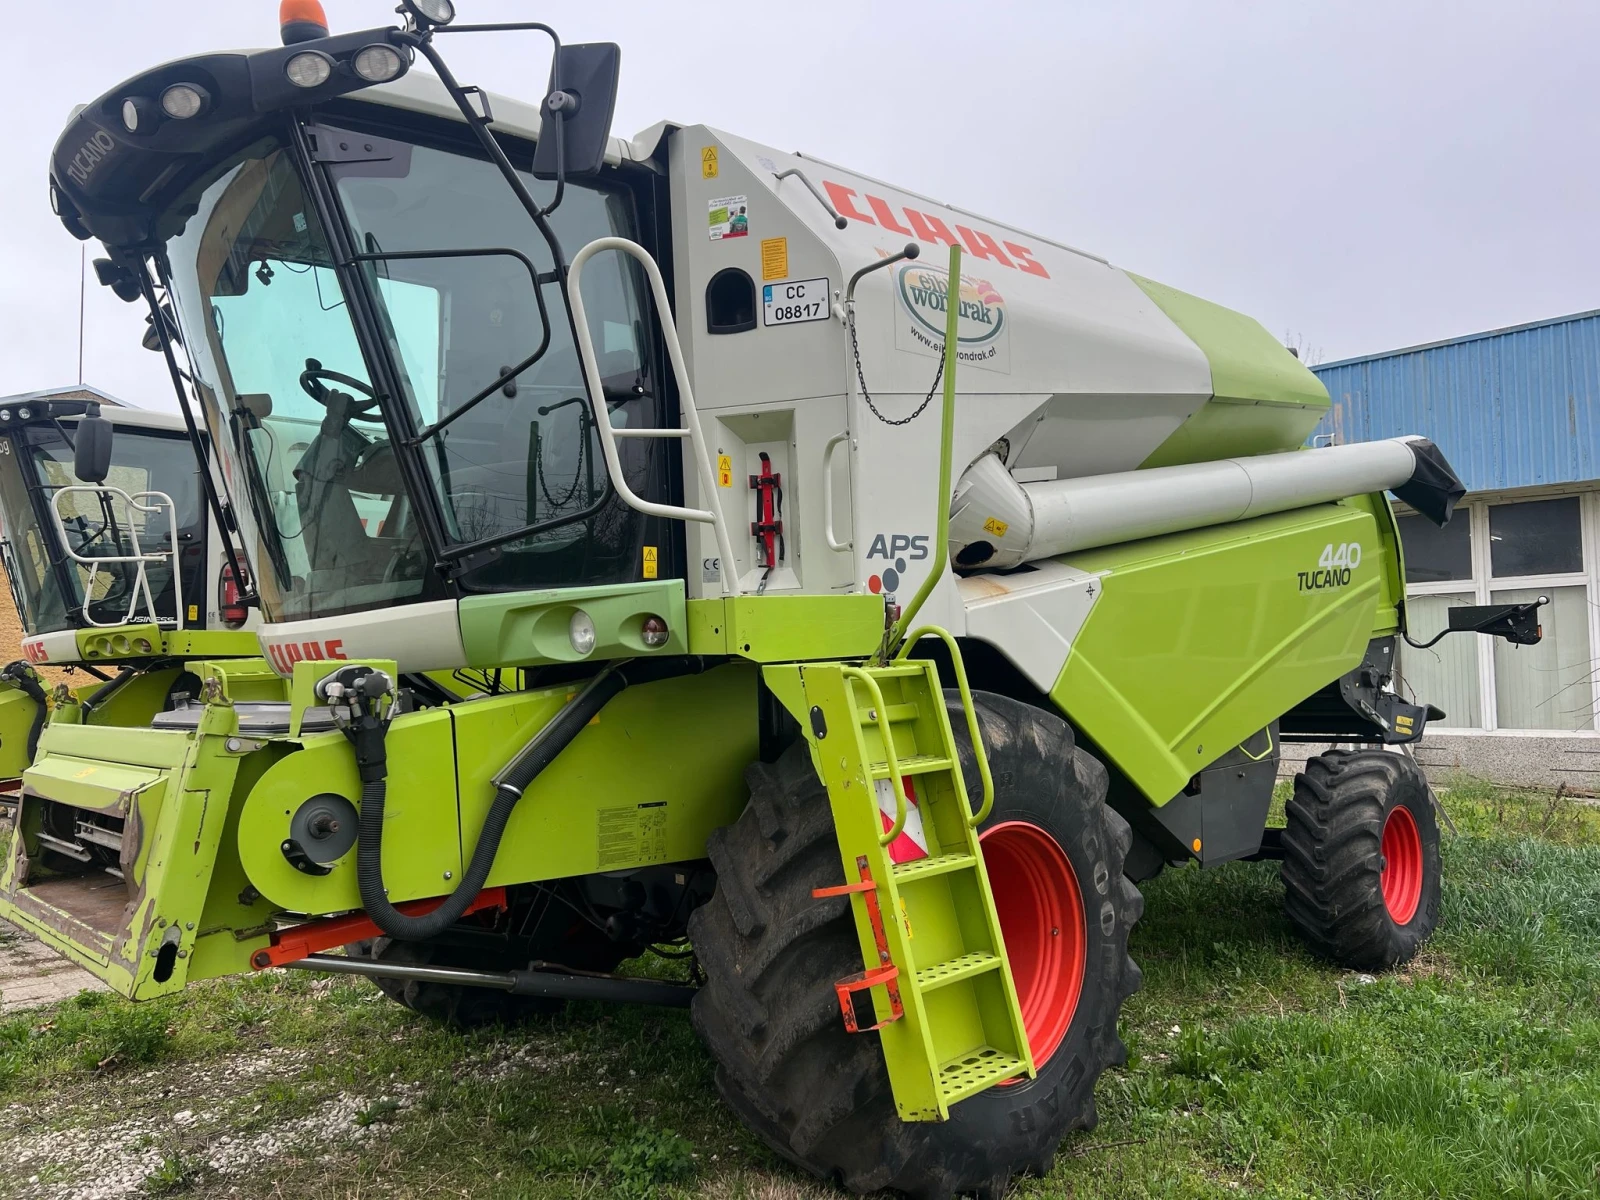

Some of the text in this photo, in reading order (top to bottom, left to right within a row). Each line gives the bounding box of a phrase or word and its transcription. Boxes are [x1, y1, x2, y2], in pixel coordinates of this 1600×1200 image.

[66, 130, 115, 186] TUCANO
[822, 180, 1051, 280] CLAAS
[786, 285, 805, 299] CC
[909, 284, 993, 325] wonrak
[775, 302, 820, 321] 08817
[866, 534, 930, 560] APS
[1318, 542, 1362, 571] 440
[1297, 567, 1351, 591] TUCANO
[268, 639, 347, 674] CLAAS
